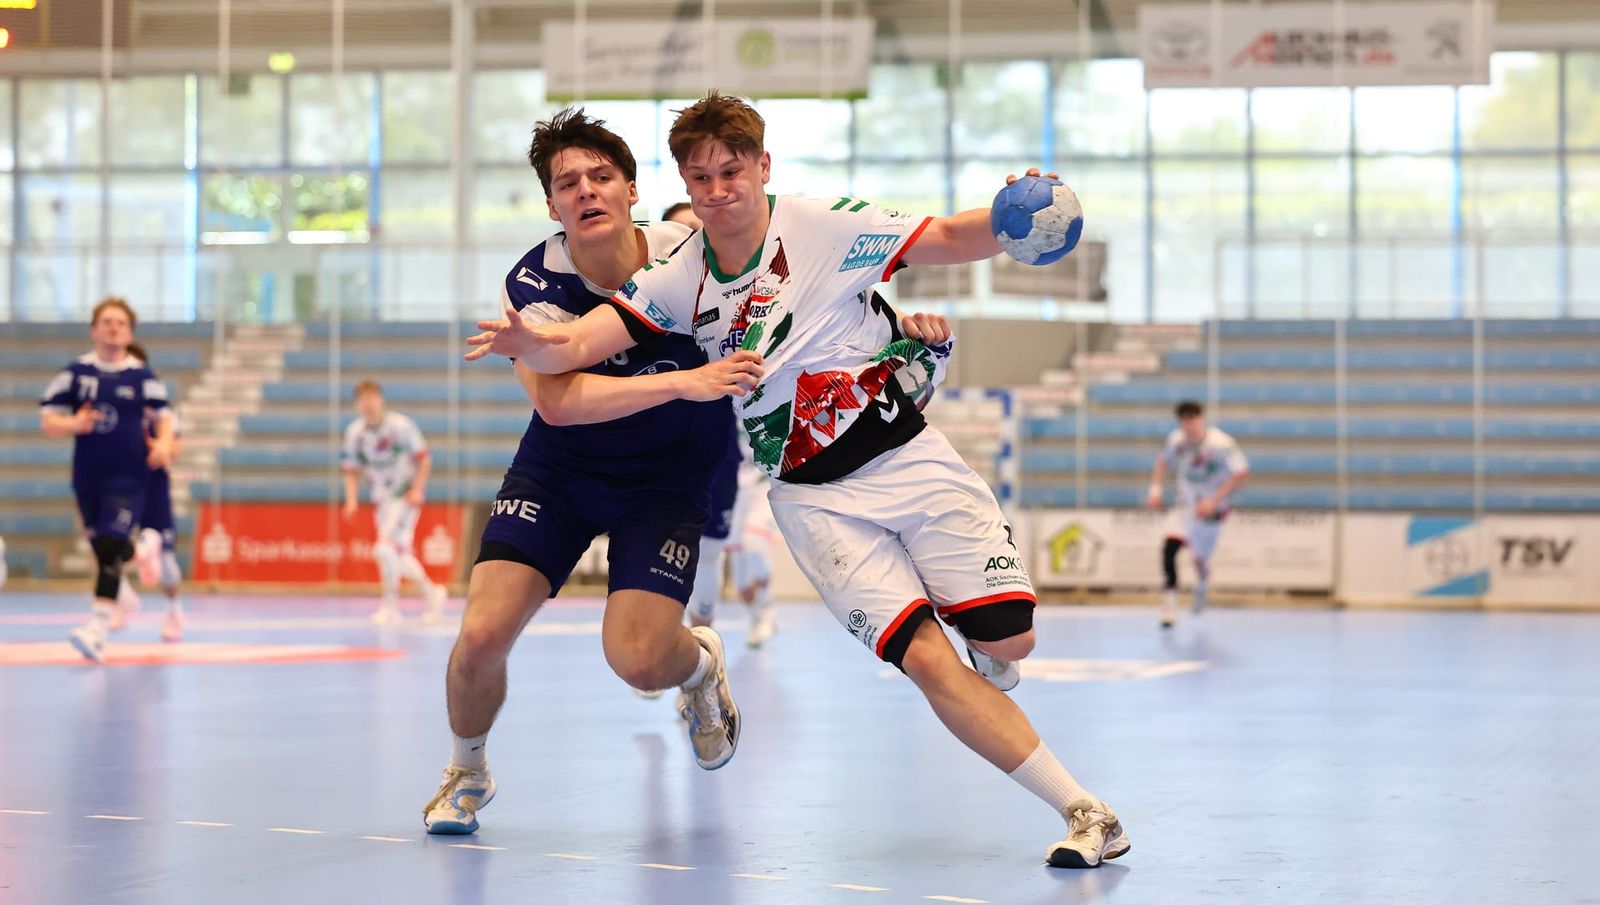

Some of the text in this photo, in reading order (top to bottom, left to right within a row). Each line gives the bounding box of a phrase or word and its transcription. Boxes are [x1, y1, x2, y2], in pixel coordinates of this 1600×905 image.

[847, 235, 897, 259] SWM
[659, 539, 690, 570] 49
[984, 556, 1019, 572] AOK
[1499, 537, 1574, 567] TSV
